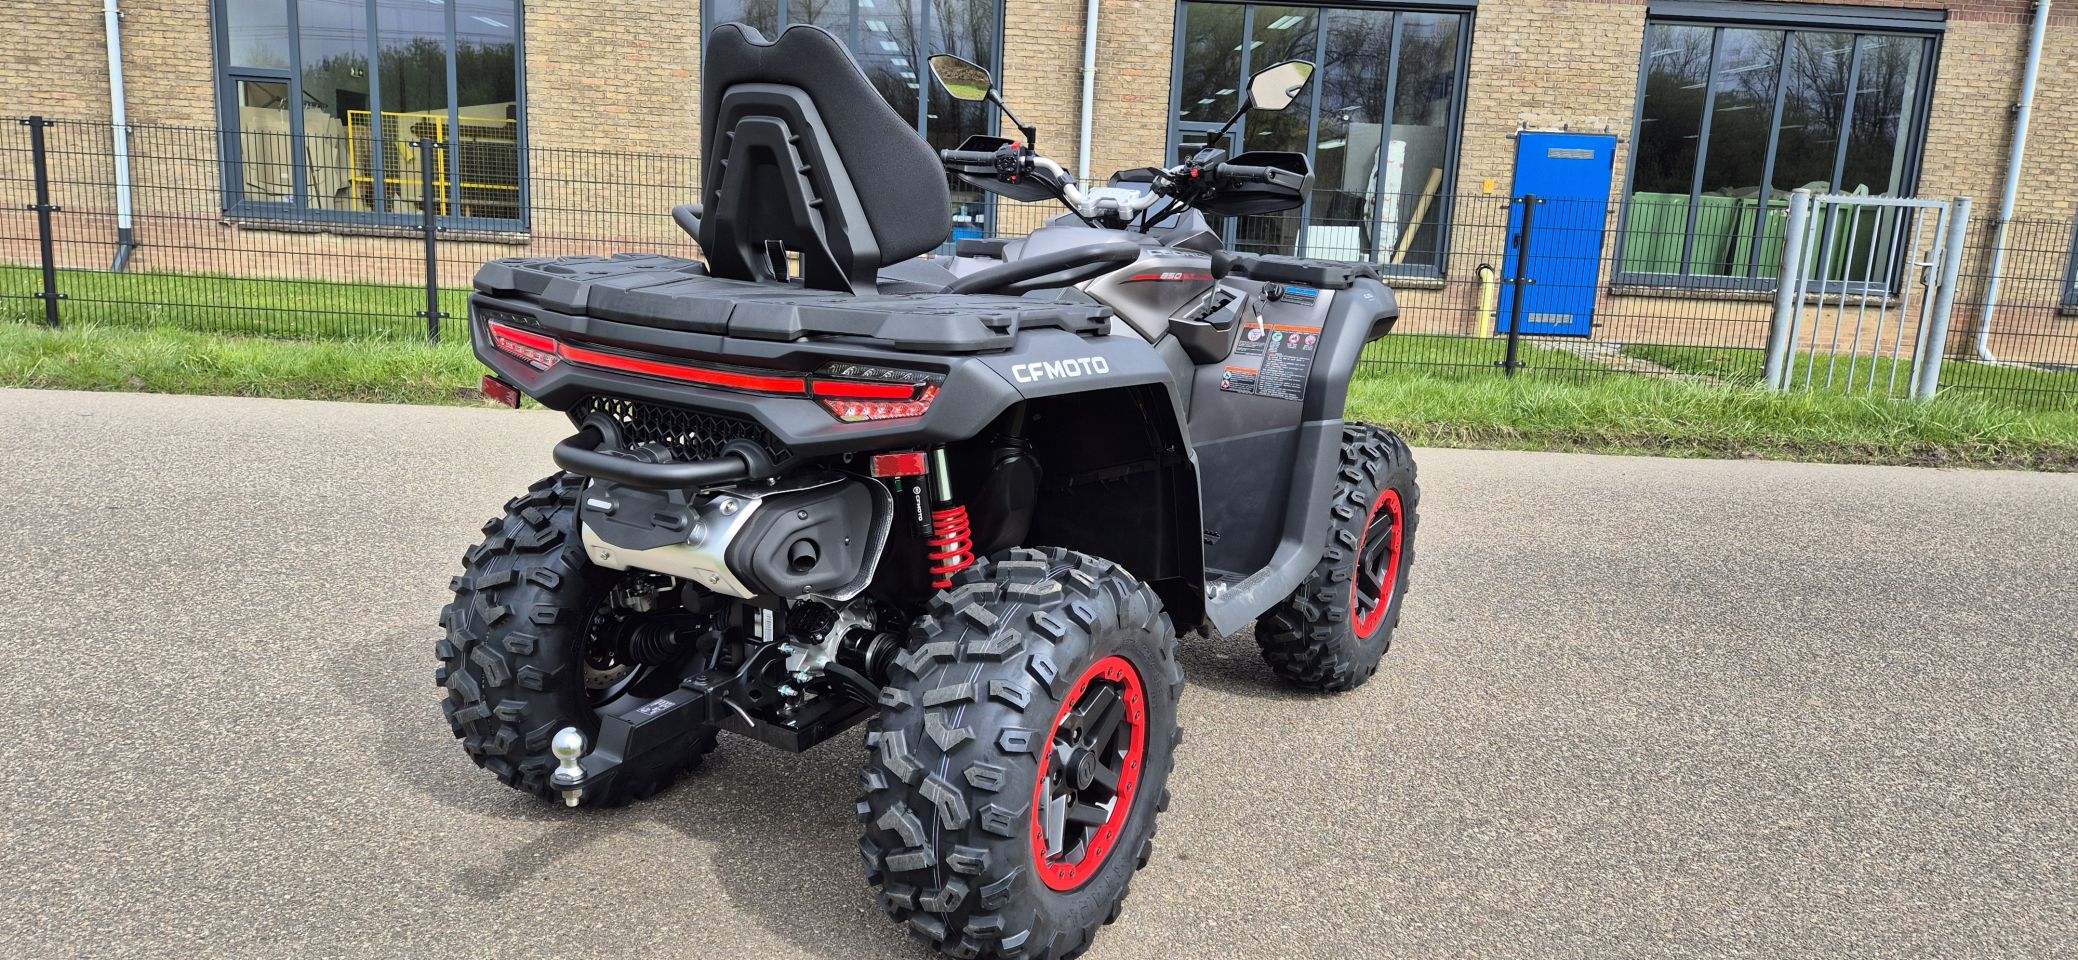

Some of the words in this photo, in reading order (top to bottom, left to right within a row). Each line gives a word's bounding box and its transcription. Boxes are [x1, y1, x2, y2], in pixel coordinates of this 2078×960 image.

[1160, 272, 1182, 280] 850
[1011, 356, 1109, 383] CFMOTO
[915, 494, 923, 521] CFMOTO
